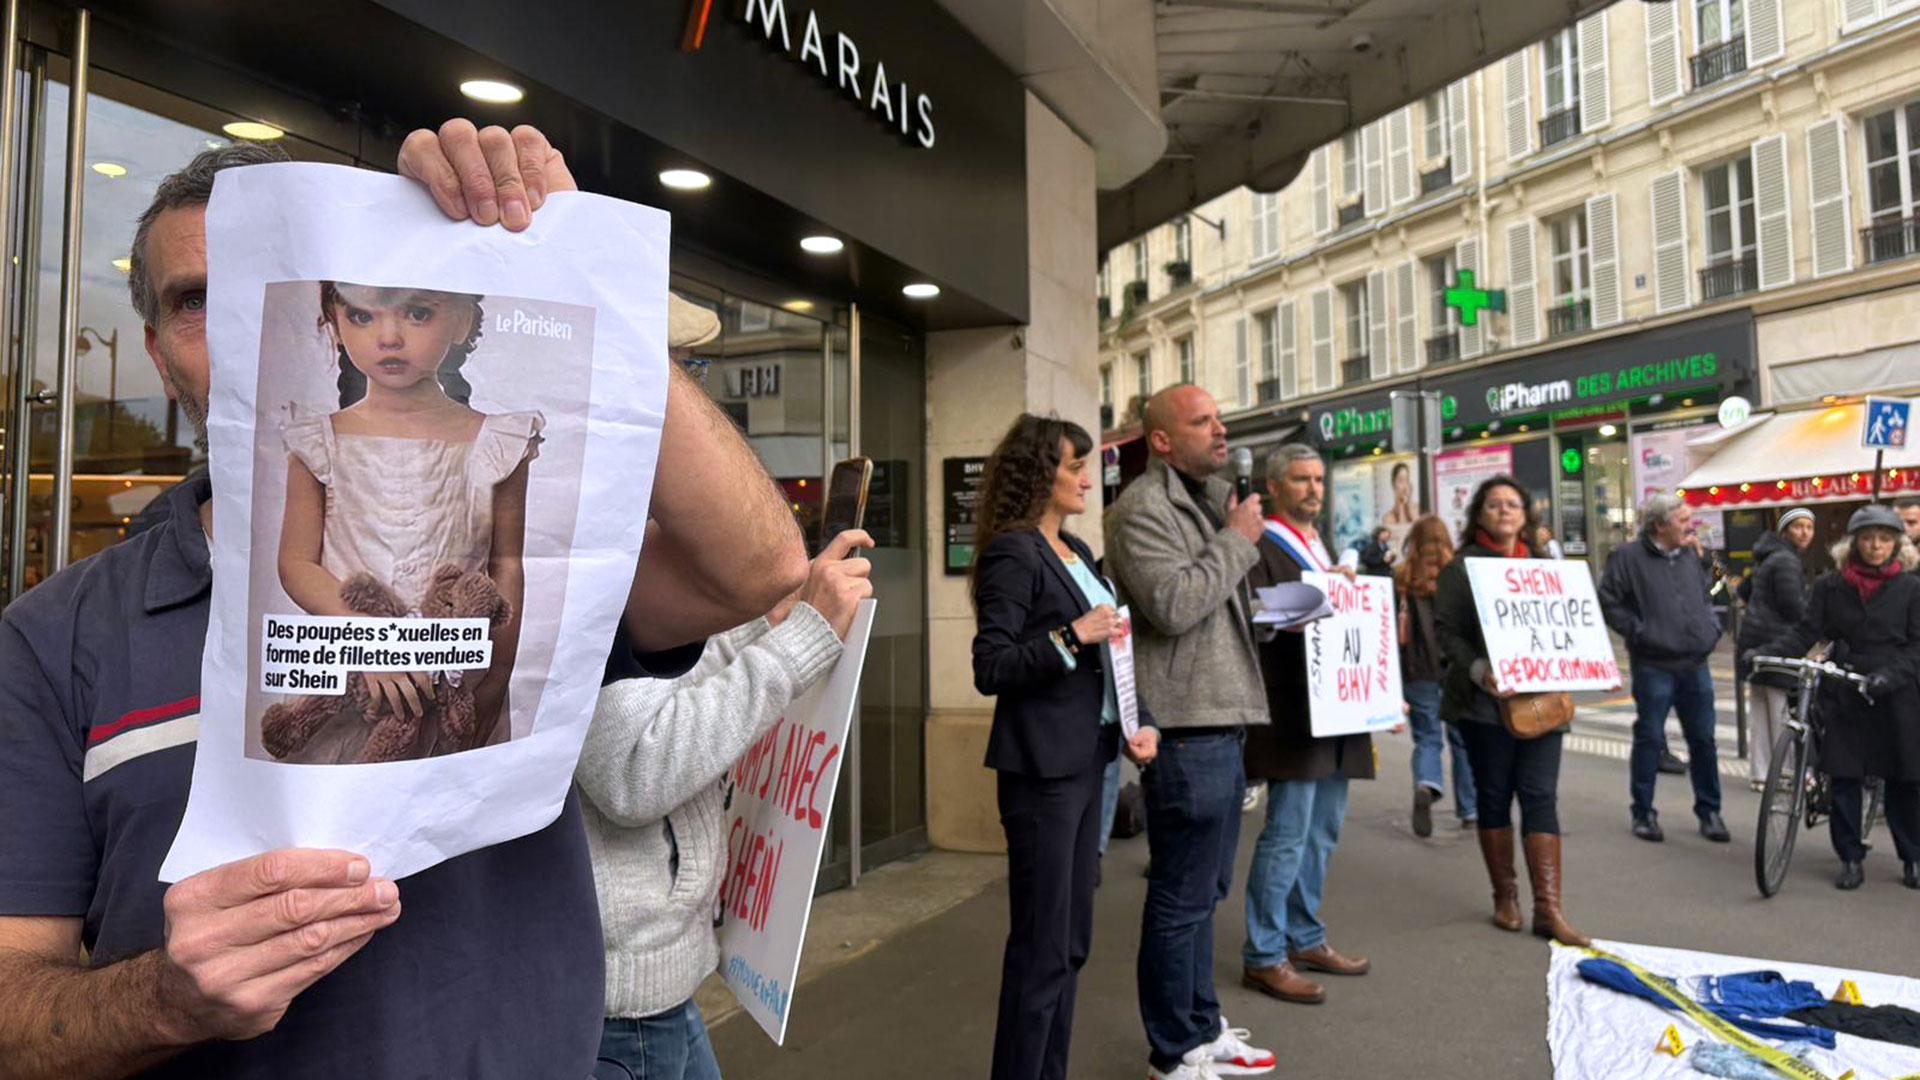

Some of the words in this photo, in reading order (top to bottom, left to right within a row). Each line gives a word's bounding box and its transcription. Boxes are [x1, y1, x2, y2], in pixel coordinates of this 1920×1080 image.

[745, 0, 936, 148] MARAIS
[496, 313, 511, 332] Le
[513, 309, 572, 340] Parisien
[1500, 379, 1571, 411] iPharm
[1577, 371, 1611, 399] DES
[1616, 352, 1717, 391] ARCHIVES
[1335, 393, 1457, 439] Phare
[964, 463, 985, 474] BHV
[1505, 563, 1563, 595] SHEIN
[1328, 579, 1372, 613] HONTE
[1494, 597, 1594, 628] PARTICIPE
[267, 619, 294, 639] Des
[296, 621, 375, 644] poupées
[462, 626, 482, 640] en
[1343, 626, 1361, 665] AU
[1529, 626, 1544, 652] À
[1552, 630, 1574, 651] LA
[265, 643, 310, 664] forme
[313, 645, 336, 664] de
[339, 645, 411, 666] fillettes
[414, 646, 484, 665] vendues
[265, 672, 287, 687] sur
[288, 668, 338, 689] Shein
[1338, 664, 1371, 701] BHV
[773, 723, 839, 829] AVEC
[719, 816, 784, 932] SHEIN
